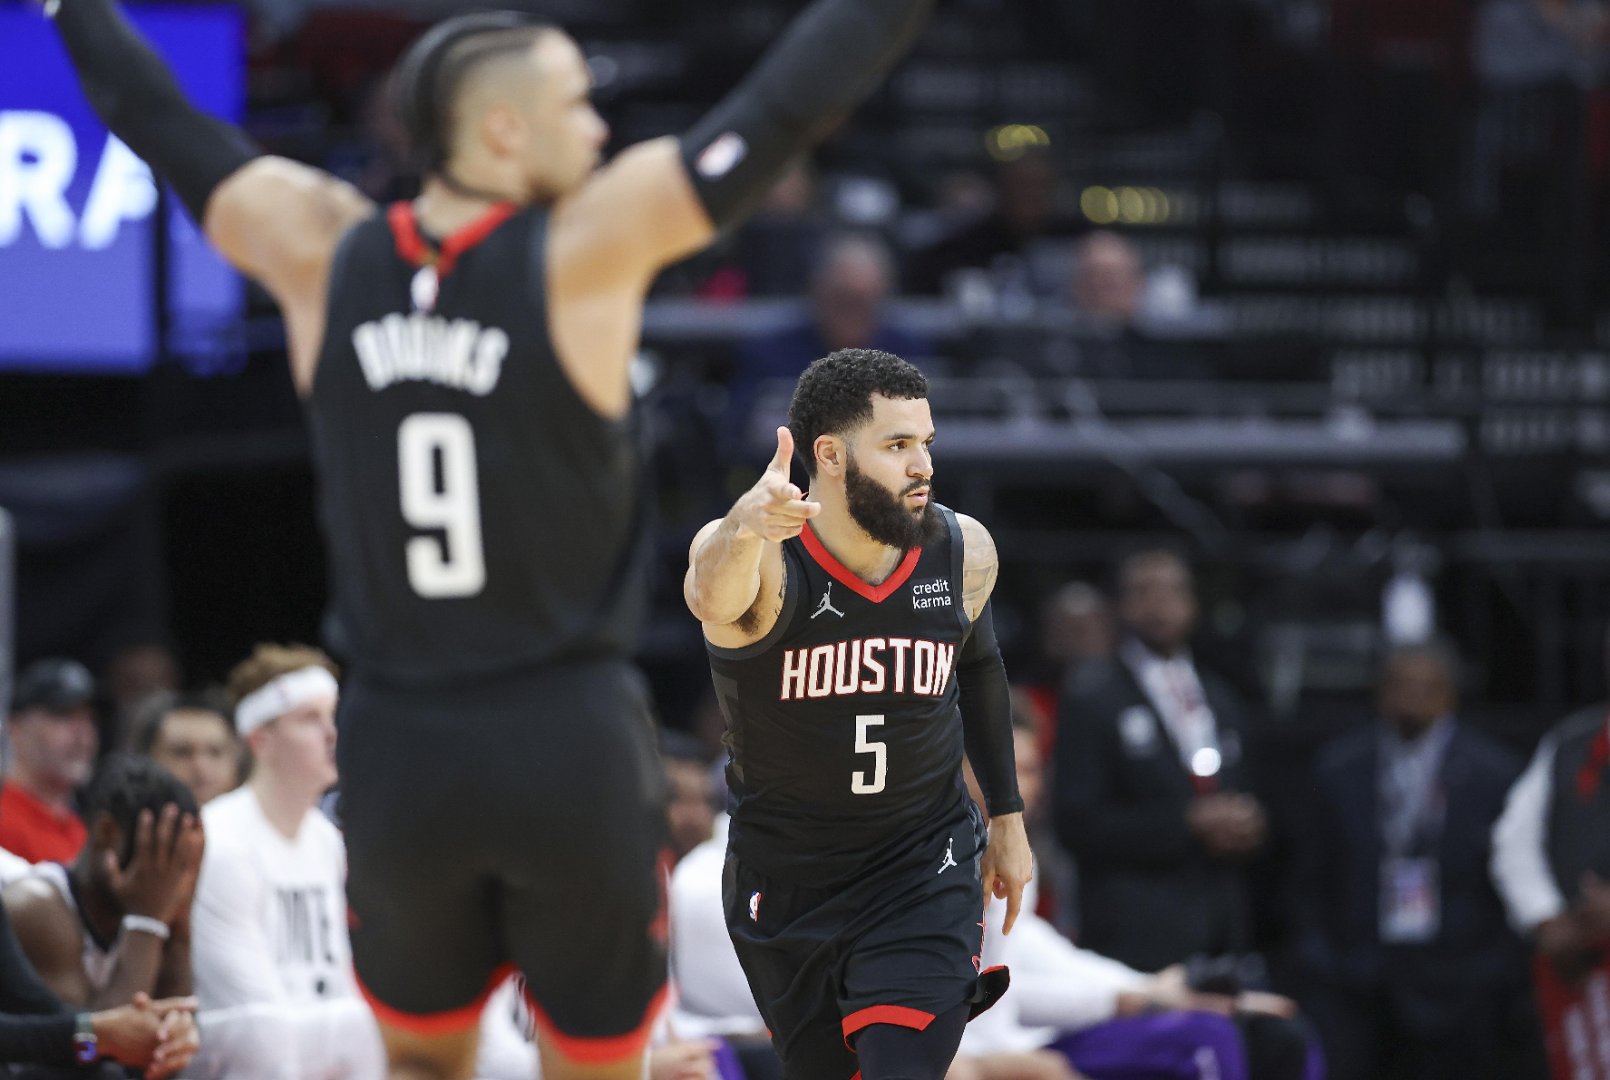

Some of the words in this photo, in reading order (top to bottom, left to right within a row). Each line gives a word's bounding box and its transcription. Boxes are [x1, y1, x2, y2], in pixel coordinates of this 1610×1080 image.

[397, 411, 487, 599] 9
[912, 595, 951, 610] karma
[913, 579, 950, 595] credit
[781, 636, 955, 700] HOUSTON
[851, 714, 887, 794] 5
